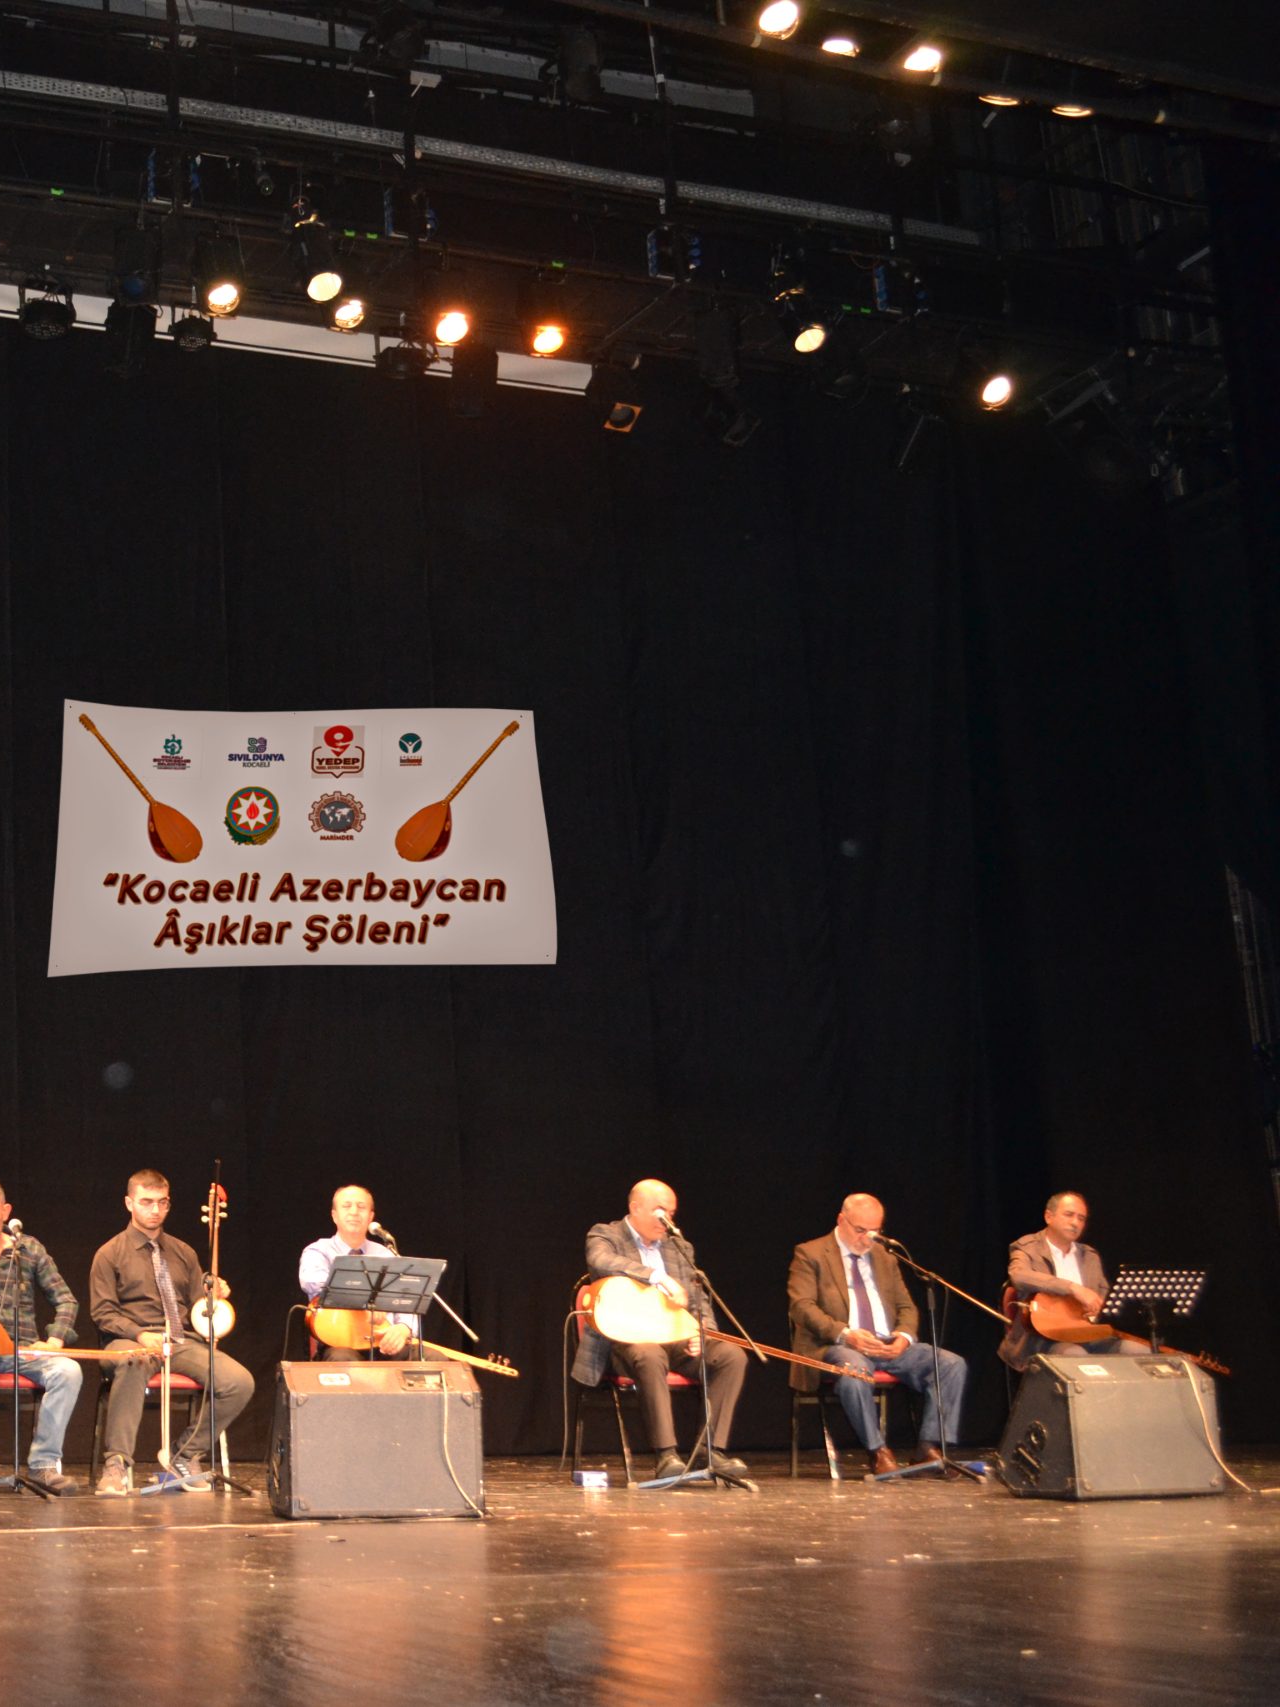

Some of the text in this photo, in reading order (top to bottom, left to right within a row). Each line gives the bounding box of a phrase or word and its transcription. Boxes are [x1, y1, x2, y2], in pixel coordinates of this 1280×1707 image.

[315, 757, 361, 766] YEDEP
[270, 871, 508, 910] Azerbaycan
[154, 908, 293, 955] Âşıklar
